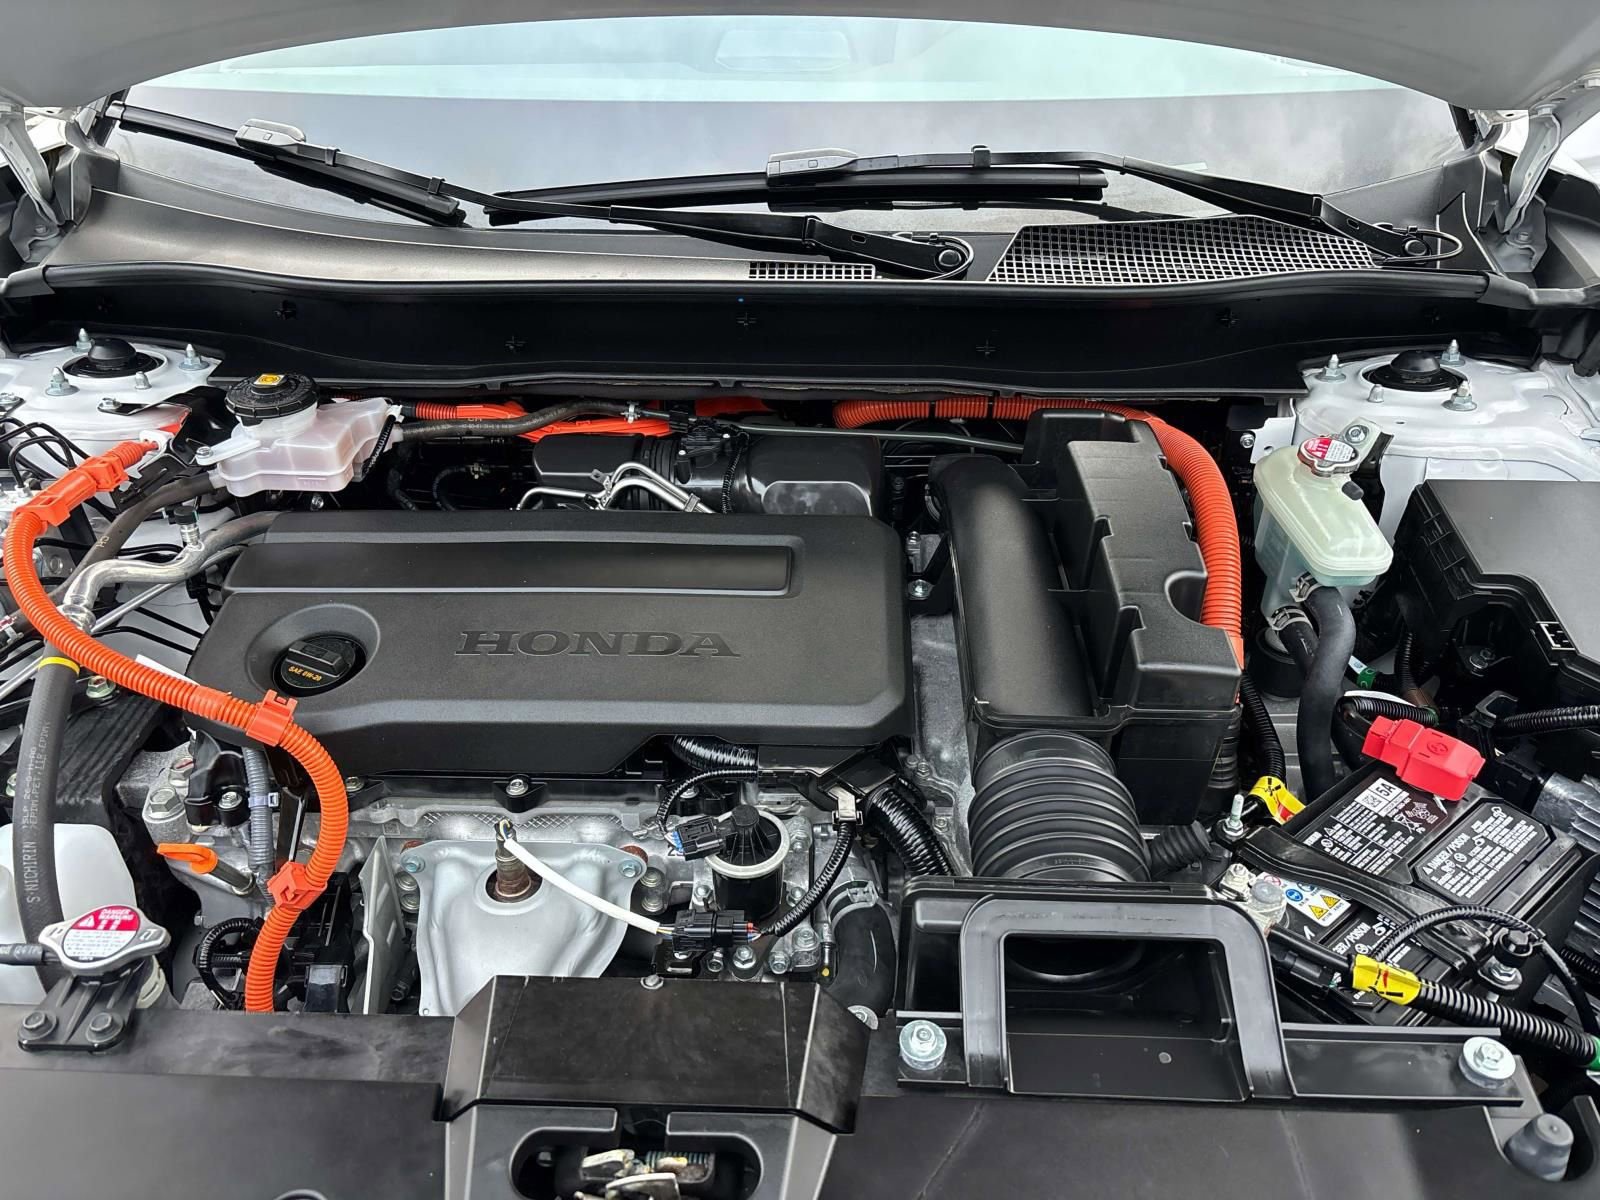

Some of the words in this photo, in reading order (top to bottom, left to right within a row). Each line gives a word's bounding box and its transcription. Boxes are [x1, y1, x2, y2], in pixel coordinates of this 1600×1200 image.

[455, 631, 742, 657] HONDA
[288, 665, 304, 675] SAE
[302, 670, 322, 682] 0W-20
[1375, 783, 1396, 797] 5A
[1427, 850, 1451, 869] DANGER
[1448, 833, 1470, 851] POISON
[1346, 922, 1371, 943] POISON
